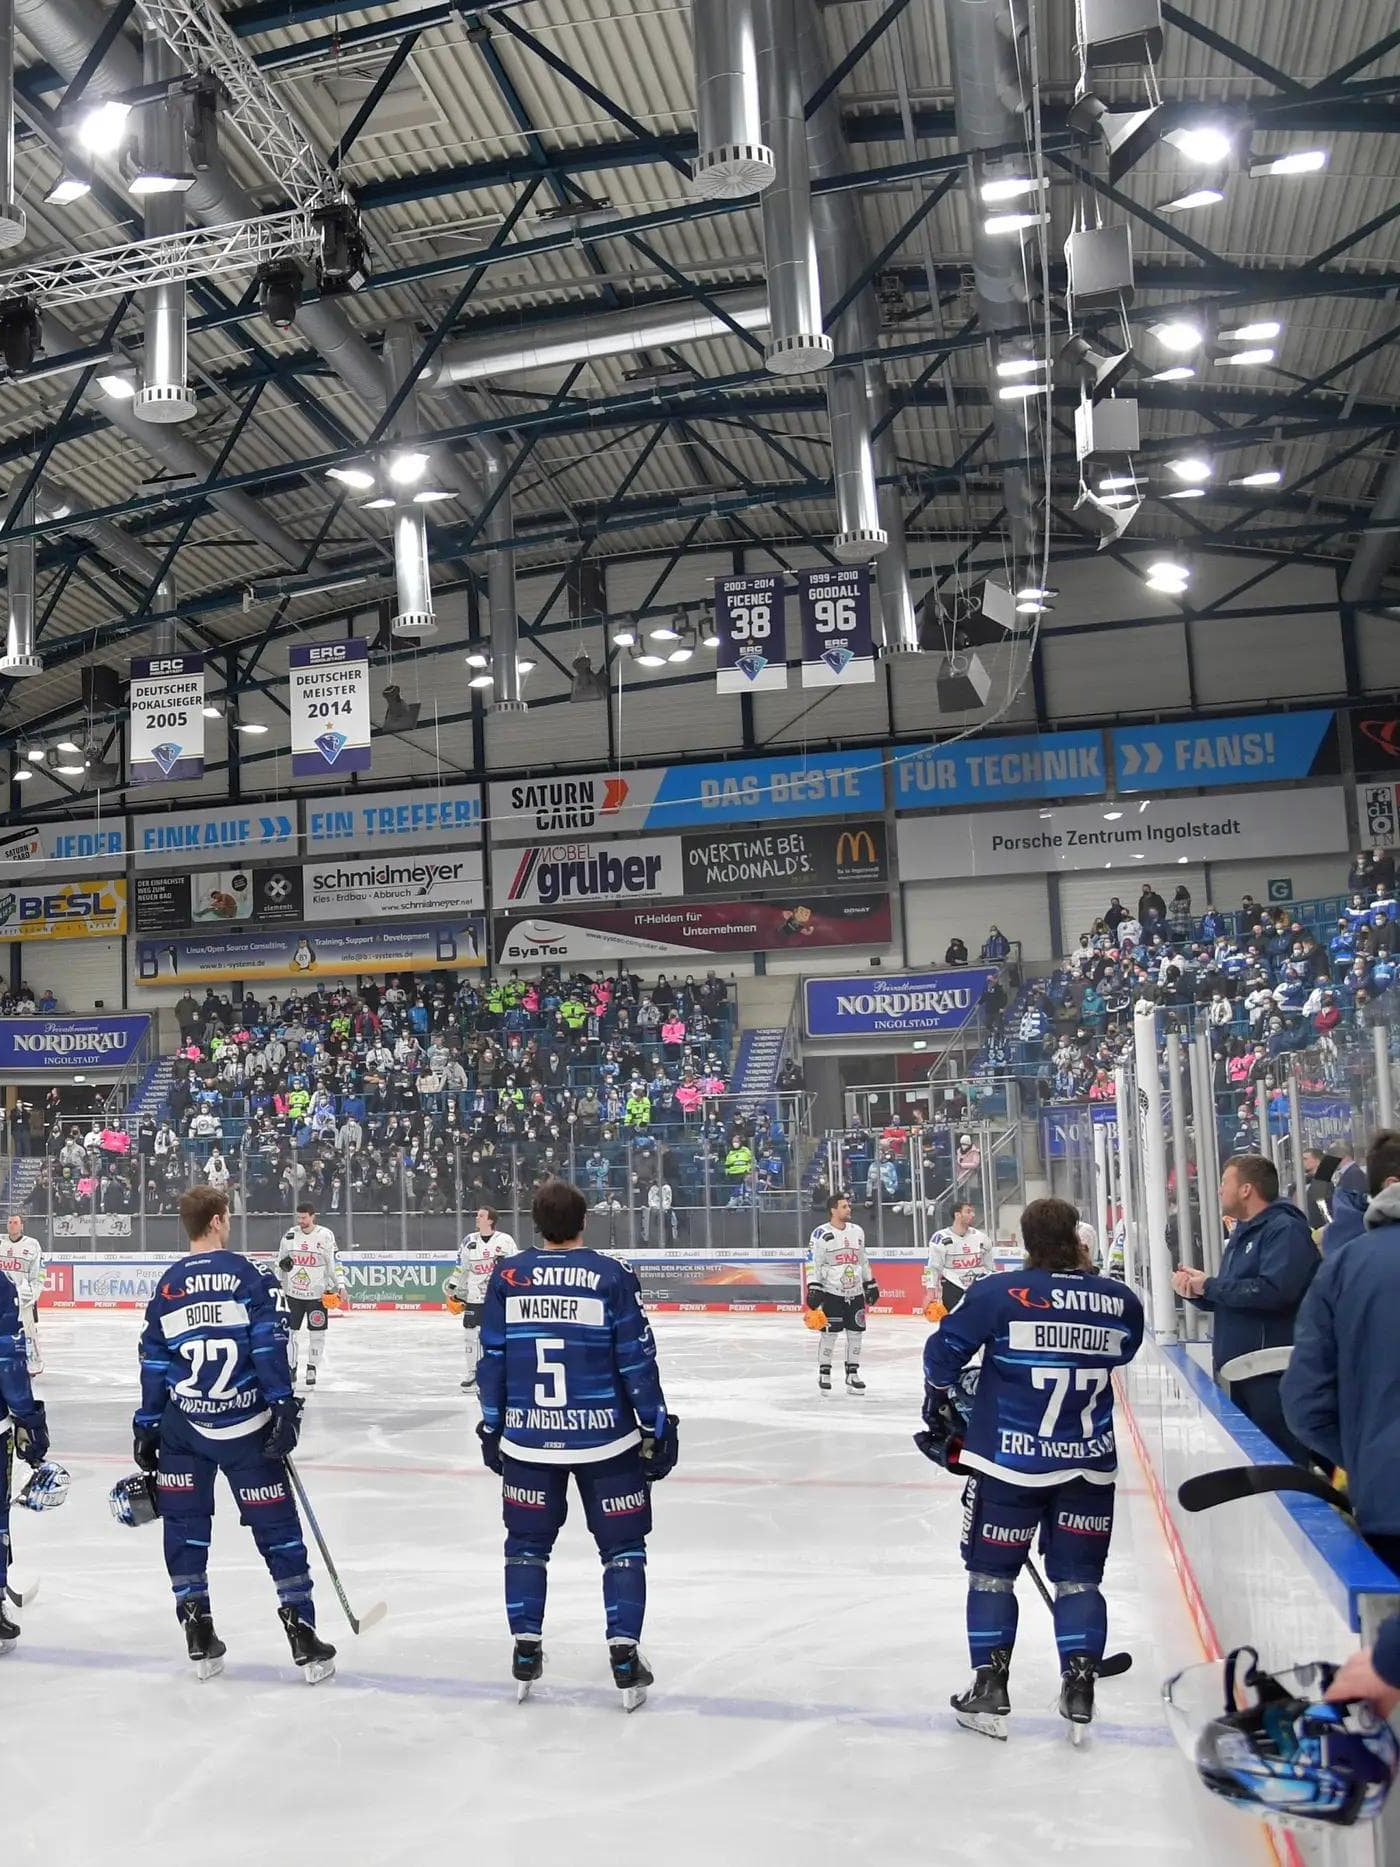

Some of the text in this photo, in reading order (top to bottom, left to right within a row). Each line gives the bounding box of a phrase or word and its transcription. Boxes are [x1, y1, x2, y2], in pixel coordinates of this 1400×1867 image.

[727, 593, 772, 608] FICENEC
[809, 586, 860, 600] GOODALL
[730, 606, 771, 640] 38
[814, 599, 856, 633] 96
[310, 646, 345, 659] ERC
[150, 659, 183, 672] ERC
[296, 670, 362, 686] DEUTSCHER
[136, 683, 197, 697] DEUTSCHER
[303, 685, 356, 699] MEISTER
[132, 695, 202, 711] POKALSIEGER
[308, 700, 352, 718] 2014
[146, 712, 187, 729] 2005
[900, 732, 1275, 792] FÜR TECHNIK FANS!
[512, 780, 594, 809] SATURN
[701, 768, 860, 809] DAS BESTE
[312, 799, 480, 840] EIN TREFFER!
[536, 804, 595, 830] CARD
[52, 831, 122, 861] JEDER
[144, 819, 250, 854] EINKAUF
[992, 819, 1241, 851] Porsche Zentrum Ingolstadt
[538, 844, 595, 863] MÖBEL
[313, 863, 463, 890] schmidmeyer
[537, 852, 662, 903] gruber
[337, 894, 366, 902] Erdbau
[374, 888, 411, 898] Abbruch
[1271, 882, 1289, 898] G
[20, 893, 116, 920] BESL
[634, 911, 702, 924] IT-Helden für
[683, 923, 757, 937] Unternehmen
[509, 945, 568, 958] SysTec
[836, 989, 971, 1018] NORDBRÄU
[873, 1017, 940, 1029] INGOLSTADT
[13, 1031, 128, 1054] NORDBRÄU
[44, 1055, 100, 1065] INGOLSTADT
[532, 1267, 600, 1291] SATURN
[519, 1299, 577, 1320] WAGNER
[1052, 1289, 1124, 1318] SATURN
[186, 1304, 223, 1326] BODIE
[1035, 1325, 1110, 1352] BOURQUE
[175, 1338, 238, 1400] 22
[534, 1338, 567, 1408] 5
[1031, 1367, 1108, 1439] 77
[526, 1408, 616, 1430] INGOLSTADT
[1001, 1431, 1035, 1456] ERC
[240, 1482, 285, 1501] CINQUE
[1058, 1512, 1111, 1532] CINQUE
